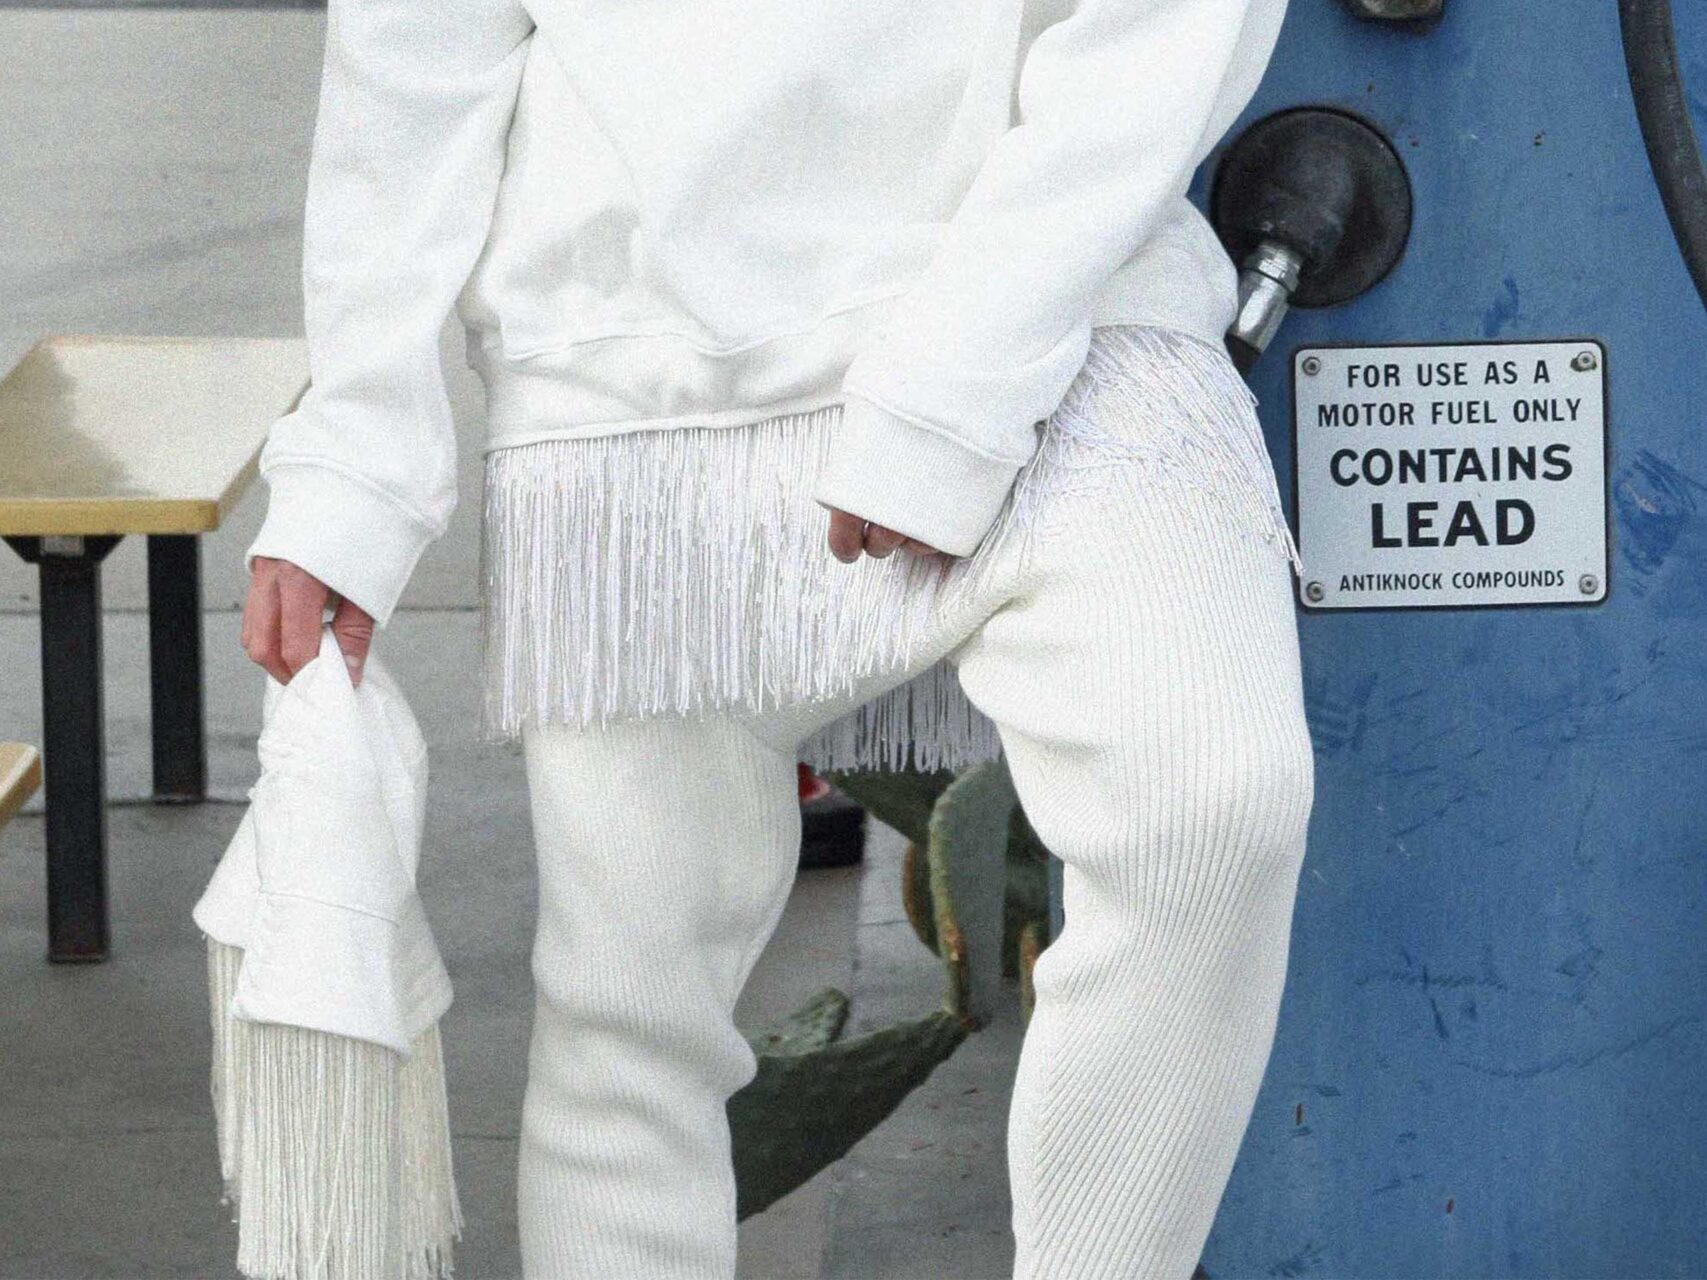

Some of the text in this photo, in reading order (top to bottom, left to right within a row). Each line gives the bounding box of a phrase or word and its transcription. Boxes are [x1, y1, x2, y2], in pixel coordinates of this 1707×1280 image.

[1348, 360, 1550, 387] FOR USE AS A
[1318, 398, 1581, 427] MOTOR FUEL ONLY
[1330, 444, 1573, 487] CONTAINS
[1371, 499, 1535, 548] LEAD
[1339, 570, 1564, 591] ANTIKNOCK COMPOUNDS
